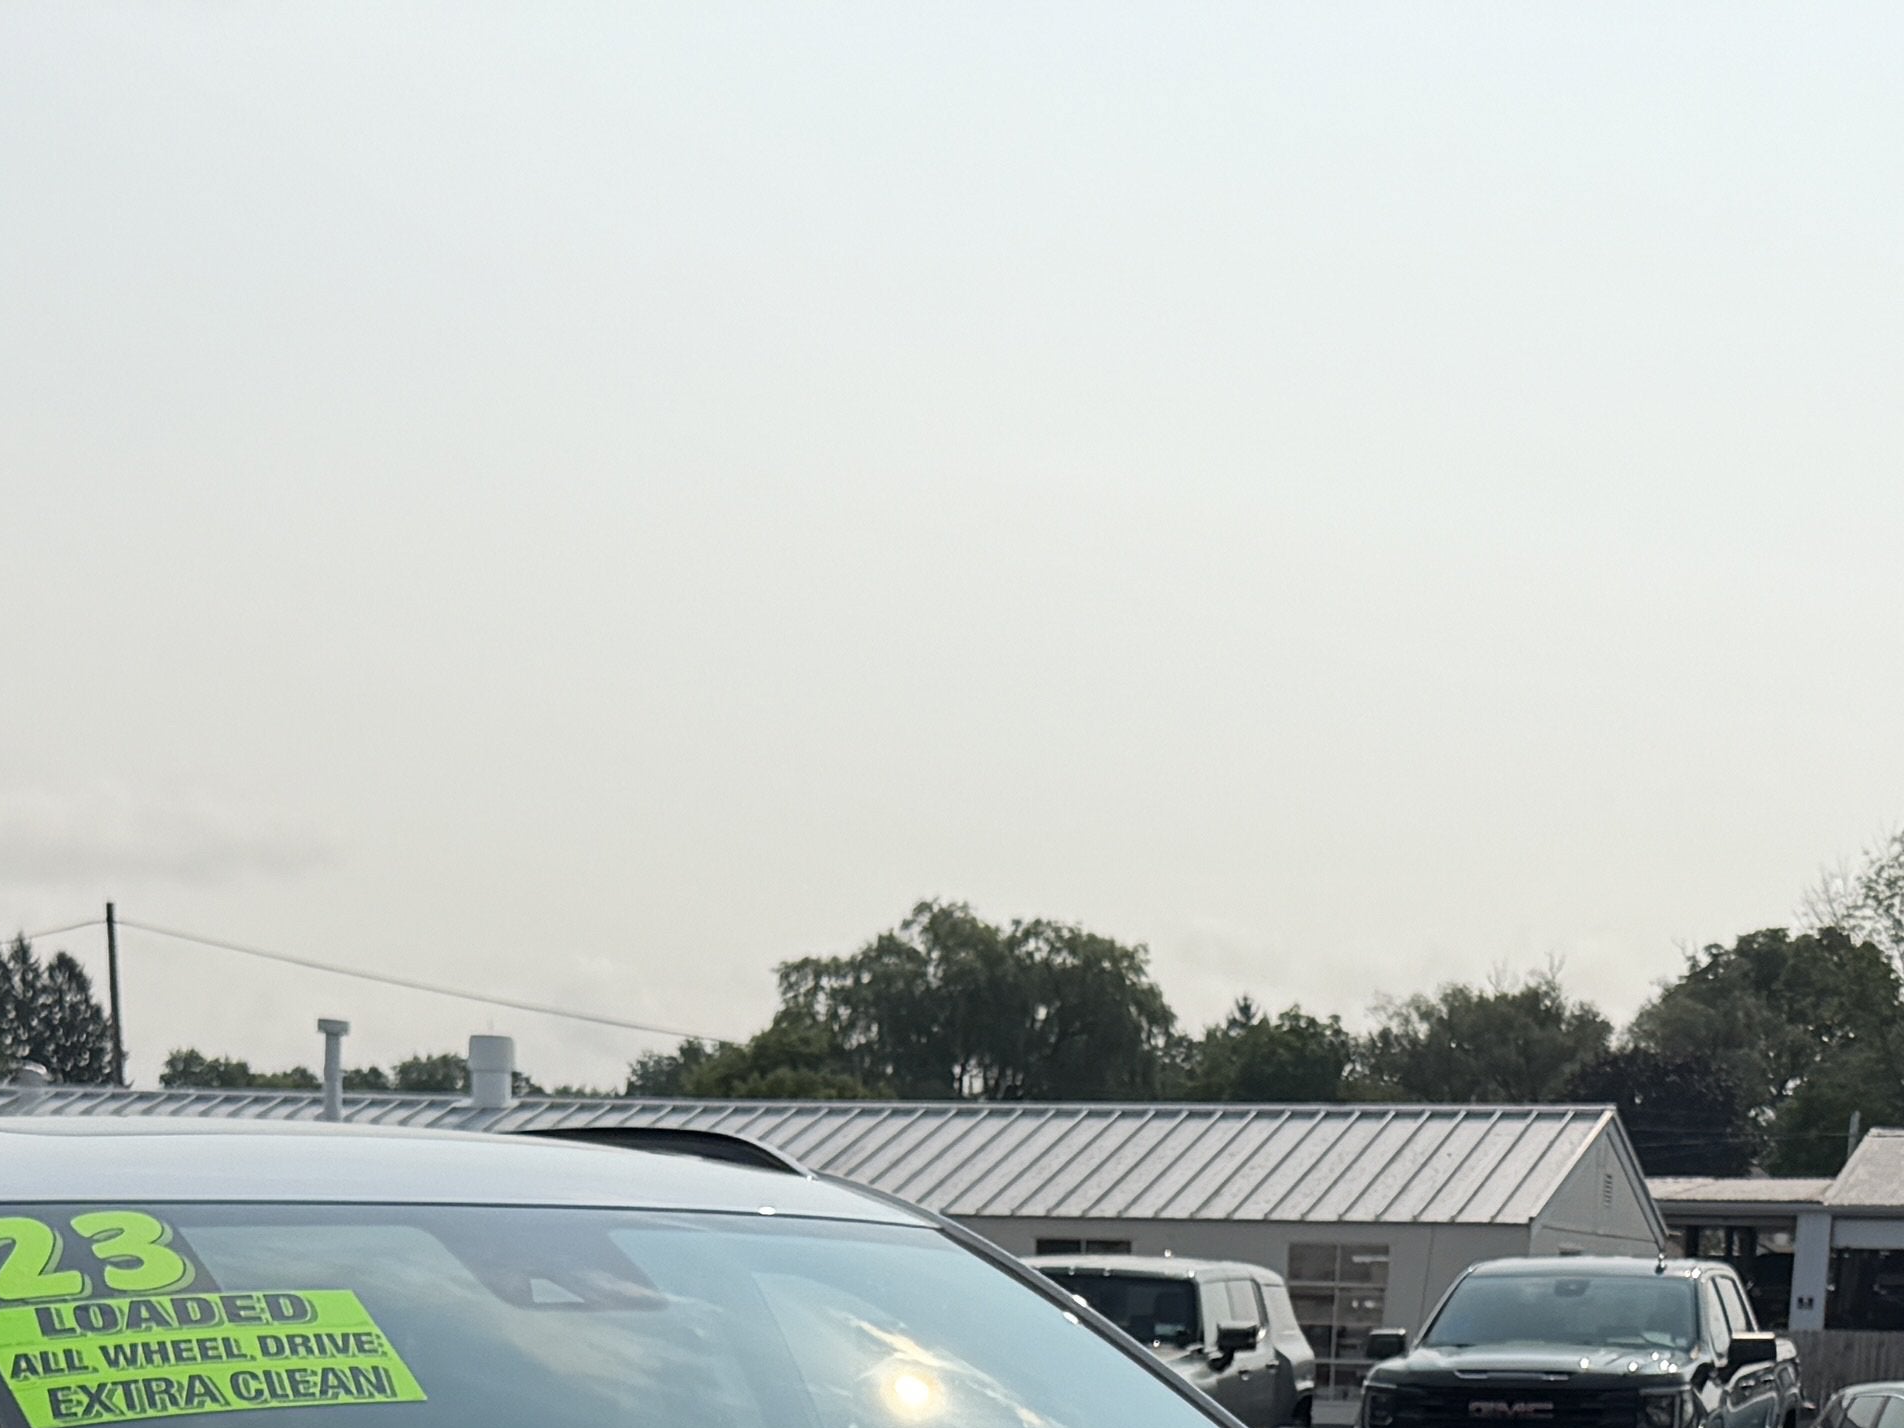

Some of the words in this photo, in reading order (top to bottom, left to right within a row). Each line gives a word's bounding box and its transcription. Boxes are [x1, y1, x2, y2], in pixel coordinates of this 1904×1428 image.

[35, 1293, 317, 1339] LOADED
[10, 1348, 98, 1381] ALL
[99, 1336, 256, 1371] WHEEL
[257, 1332, 387, 1360] DRIVE
[47, 1373, 230, 1421] EXTRA
[229, 1365, 397, 1404] CLEAN
